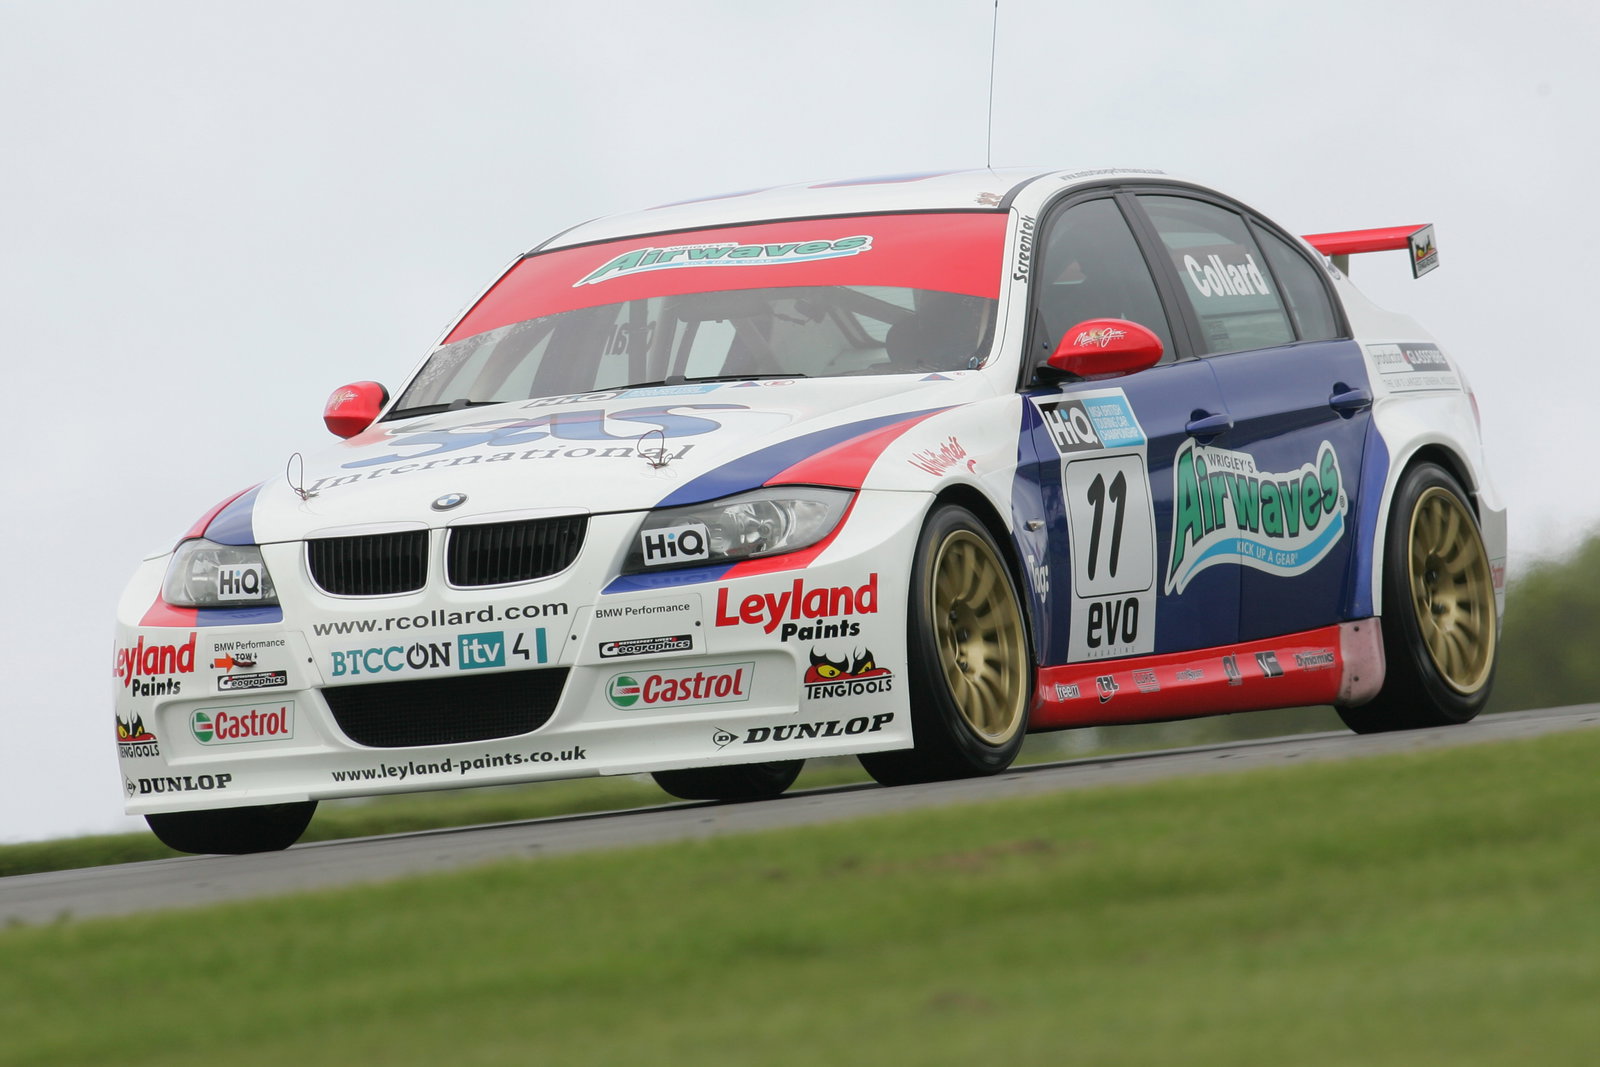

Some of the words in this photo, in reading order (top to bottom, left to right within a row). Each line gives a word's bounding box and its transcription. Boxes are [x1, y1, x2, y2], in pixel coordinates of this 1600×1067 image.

[576, 236, 871, 285] Airwaves
[1013, 215, 1035, 283] Screentek
[1183, 253, 1270, 297] Collard
[1044, 407, 1098, 446] HiQ
[308, 444, 695, 491] International
[1207, 453, 1254, 473] WRIGLEY'S
[1087, 470, 1127, 581] 11
[1169, 445, 1340, 585] Airwaves
[645, 530, 705, 560] HiQ
[1236, 540, 1254, 556] KICK
[1256, 545, 1267, 559] UP
[1267, 551, 1274, 563] A
[1275, 552, 1296, 566] GEAR
[220, 569, 259, 595] HiQ
[313, 602, 568, 636] www.rcollard.com
[596, 608, 623, 618] BMW
[625, 603, 690, 616] Performance
[715, 573, 878, 634] Leyland
[781, 619, 860, 642] Paints
[1087, 597, 1139, 649] evo
[112, 632, 197, 688] Leyland
[214, 642, 235, 652] BMW
[236, 639, 285, 650] Performance
[235, 653, 252, 661] TOW
[462, 638, 500, 664] itv
[512, 632, 530, 660] 4
[601, 639, 690, 656] Geographics
[132, 677, 181, 697] Paints
[219, 675, 286, 689] Geographics
[643, 668, 743, 704] Castrol
[806, 677, 892, 701] TENGTOOLS
[215, 707, 288, 739] Castrol
[743, 712, 894, 744] DUNLOP
[332, 746, 586, 782] www.leyland-paints.co.uk
[138, 773, 232, 794] DUNLOP
